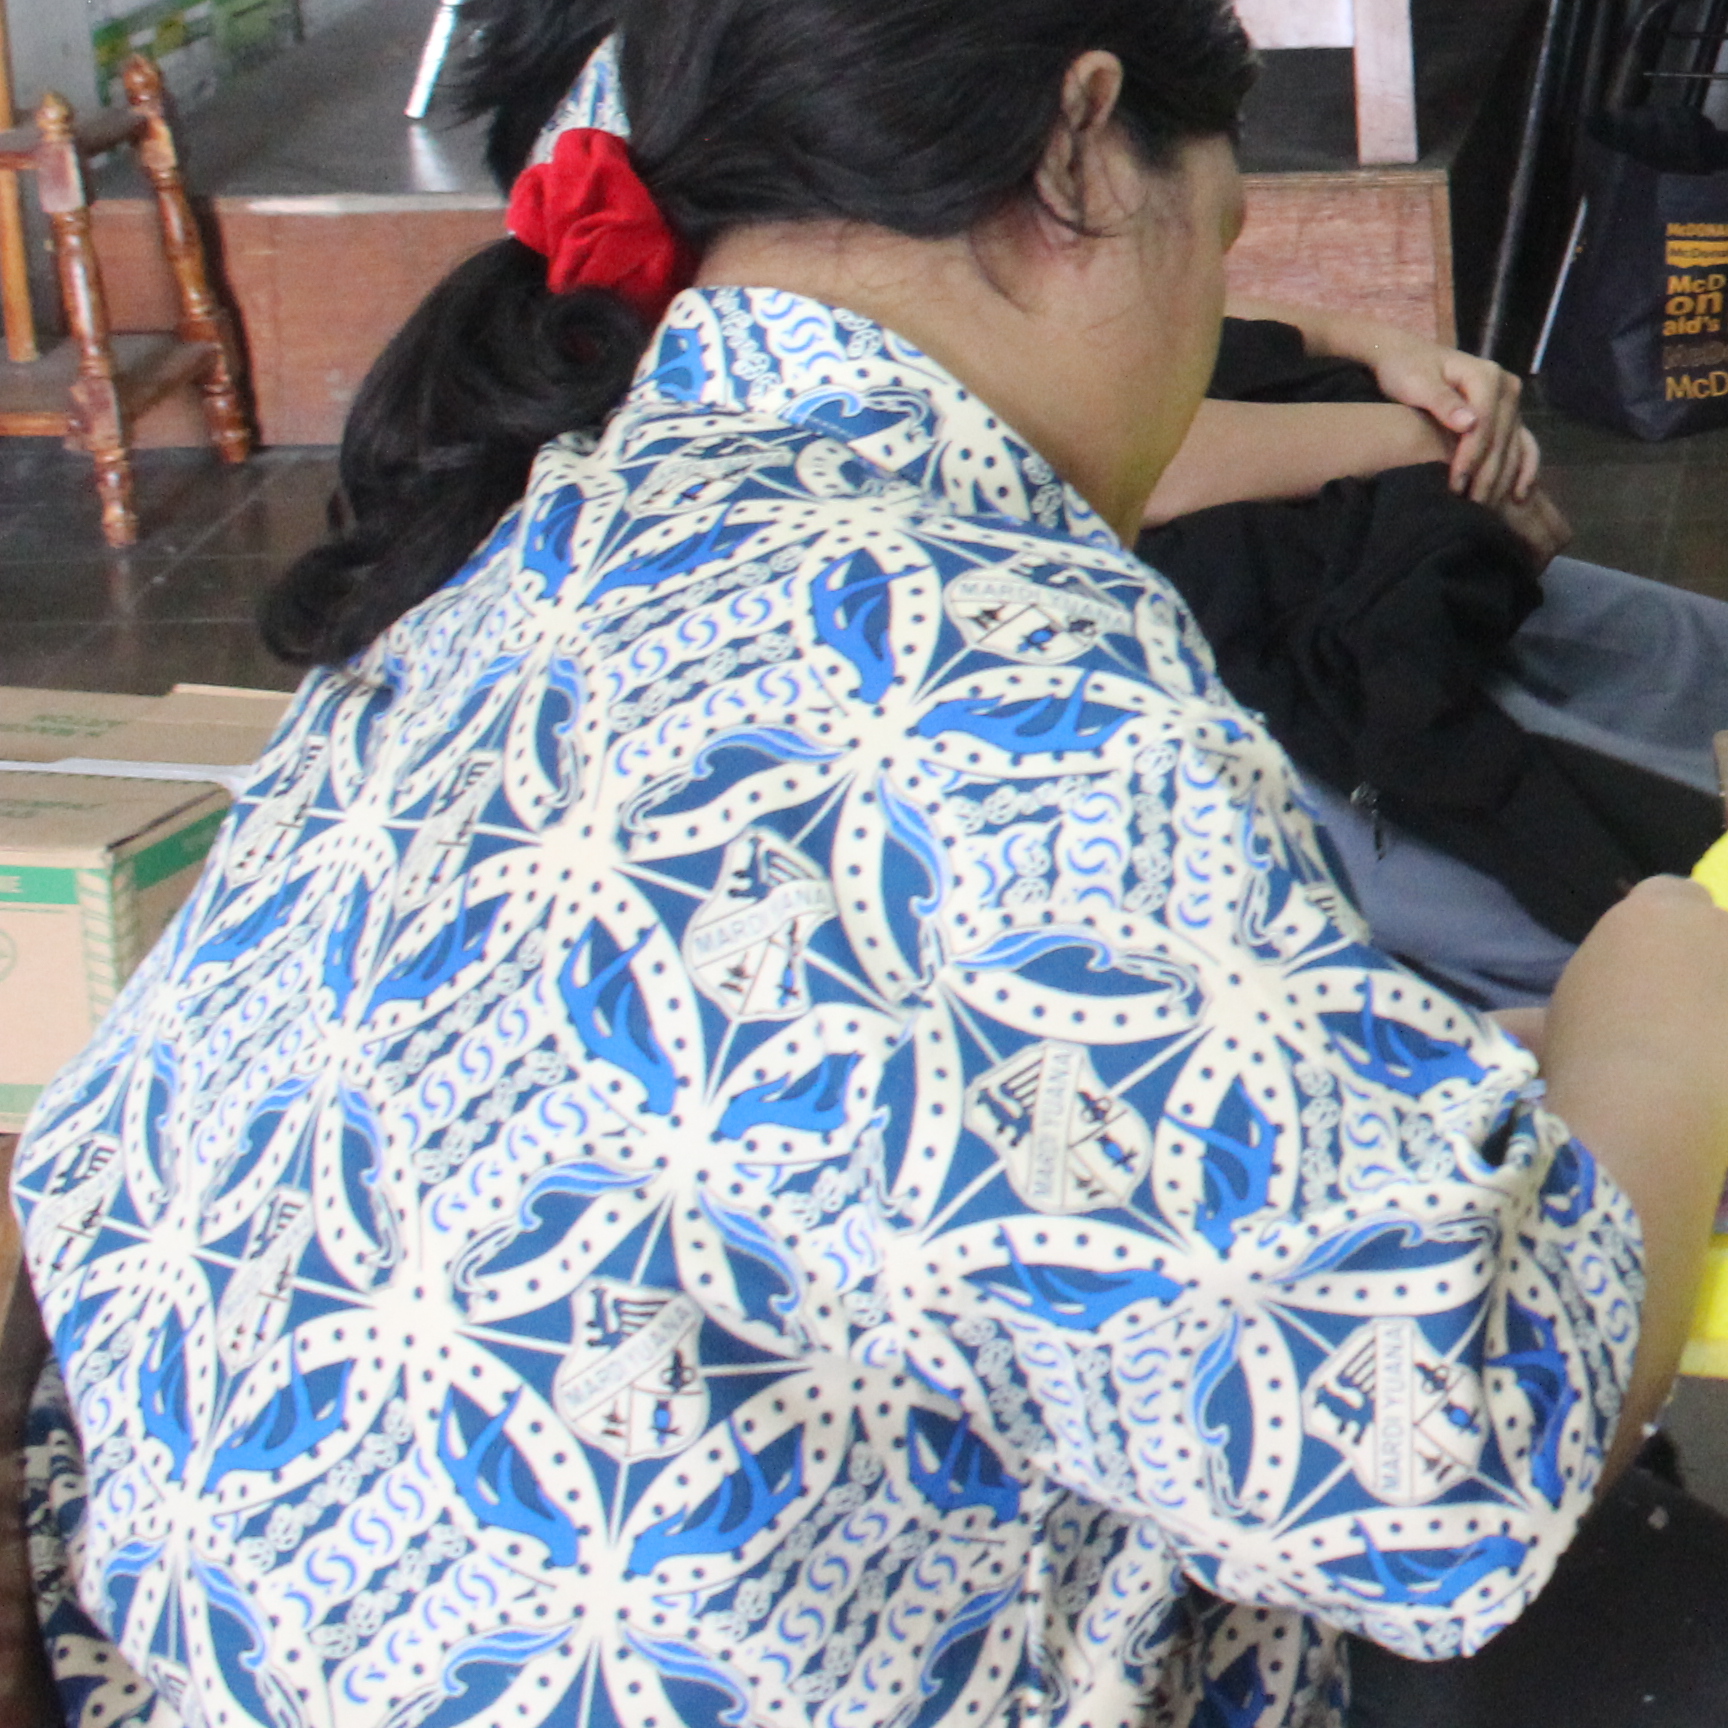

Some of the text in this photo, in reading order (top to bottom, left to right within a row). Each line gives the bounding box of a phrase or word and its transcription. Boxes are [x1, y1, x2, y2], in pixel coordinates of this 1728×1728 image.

[1665, 291, 1723, 316] on
[1666, 273, 1727, 296] McD
[1033, 1053, 1072, 1195] MARDI YUANA
[1381, 1328, 1404, 1488] MARDI YUANA
